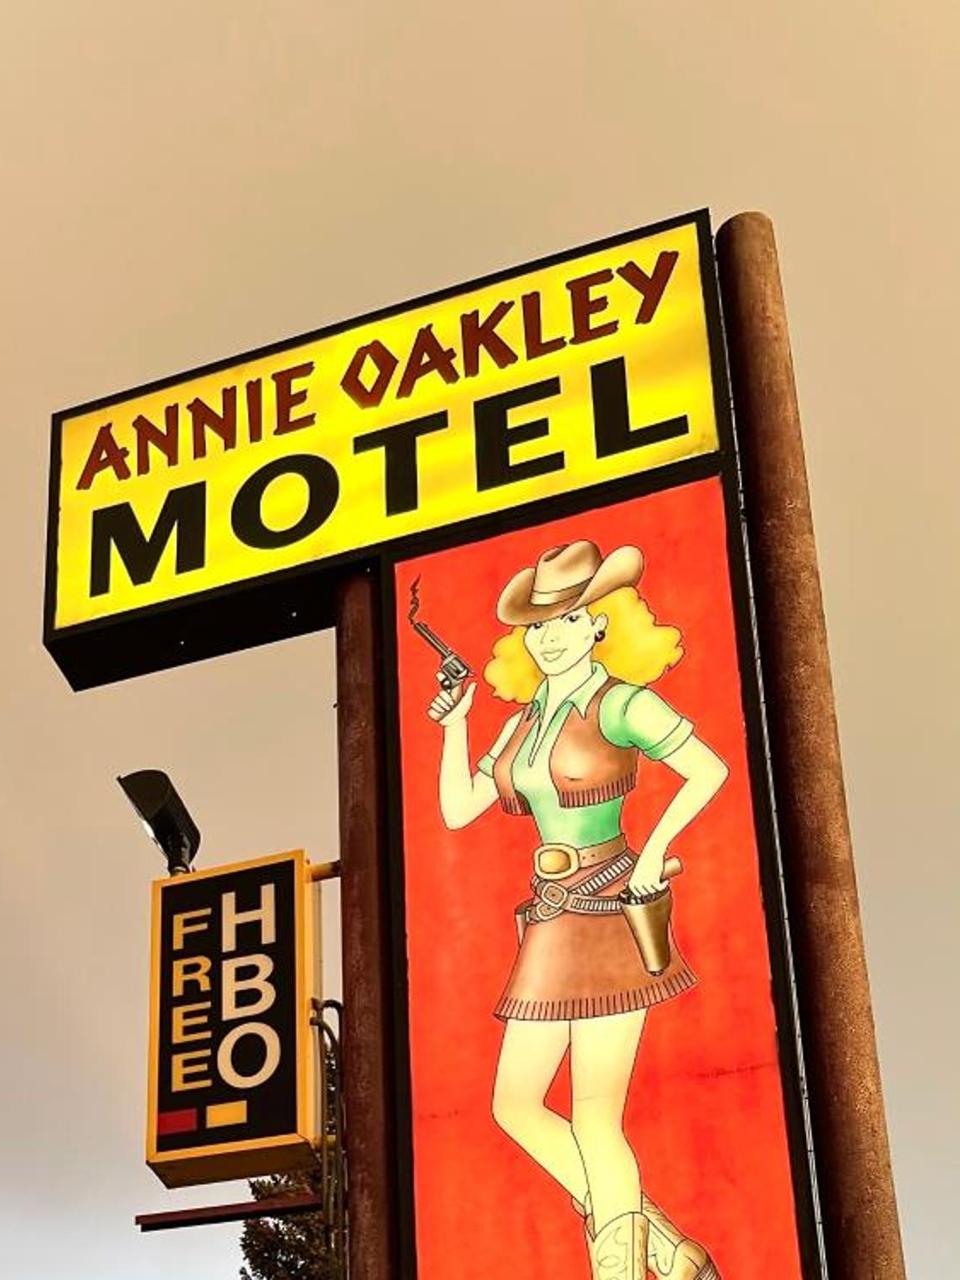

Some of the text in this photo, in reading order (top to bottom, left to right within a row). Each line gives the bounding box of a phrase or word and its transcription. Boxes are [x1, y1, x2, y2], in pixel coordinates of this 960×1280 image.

[76, 250, 679, 491] ANNIE OAKLEY
[88, 357, 690, 598] MOTEL
[171, 907, 212, 1093] FREE
[217, 883, 281, 1088] HBO
